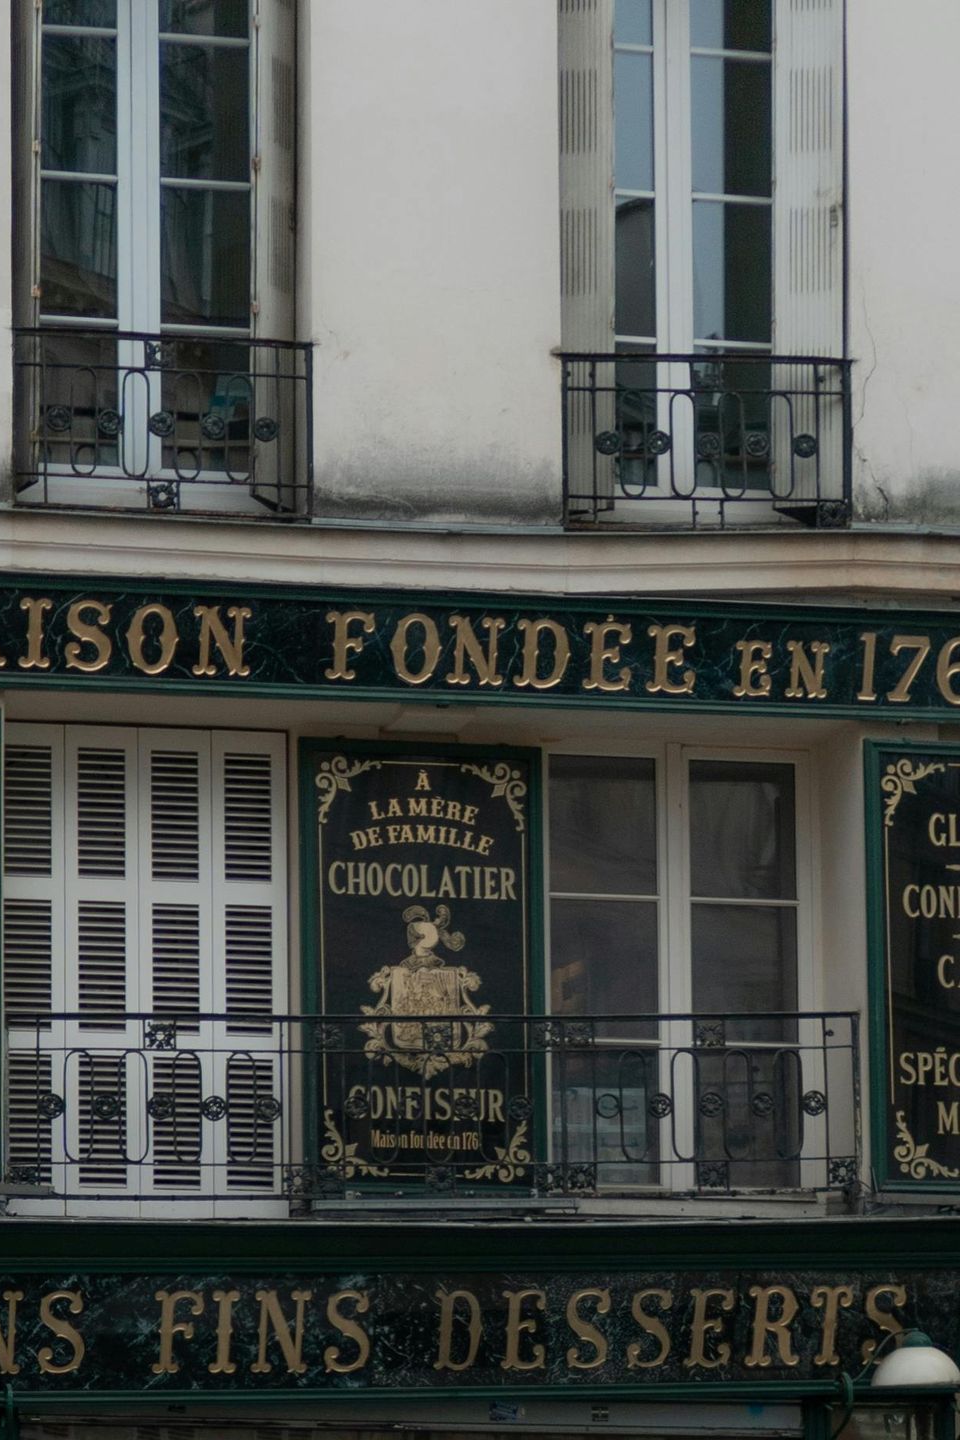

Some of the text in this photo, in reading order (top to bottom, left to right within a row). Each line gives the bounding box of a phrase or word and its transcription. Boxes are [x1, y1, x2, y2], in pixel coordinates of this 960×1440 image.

[734, 640, 829, 698] EN
[415, 768, 432, 791] À
[369, 793, 479, 825] LA MÈRE
[350, 824, 495, 857] DE FAMILLE
[328, 860, 518, 901] CHOCOLATIER
[151, 1288, 371, 1374] FINS
[434, 1284, 908, 1373] DESSERTS
